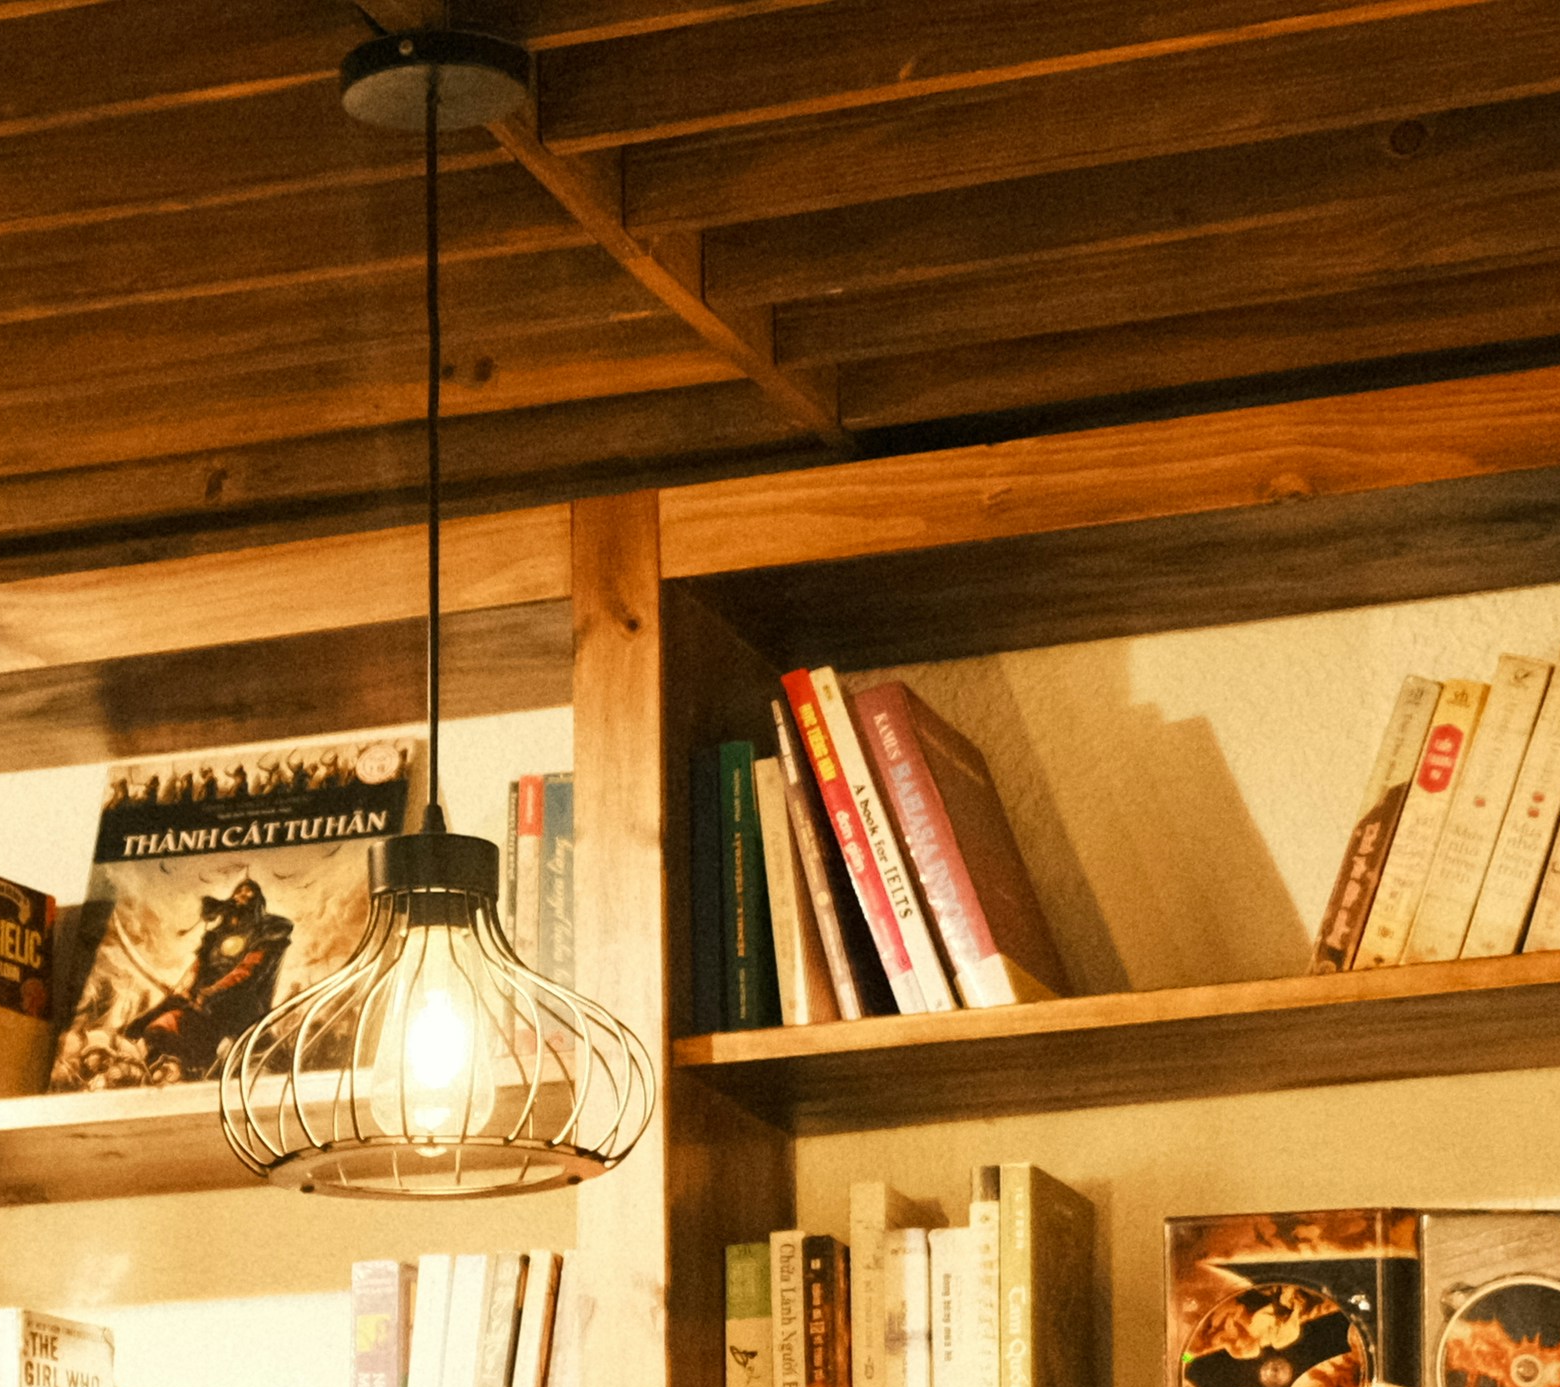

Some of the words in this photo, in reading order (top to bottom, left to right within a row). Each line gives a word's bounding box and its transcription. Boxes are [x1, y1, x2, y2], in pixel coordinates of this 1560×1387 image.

[869, 710, 903, 761] KAMUS
[123, 826, 223, 856] THÀNH
[221, 820, 282, 847] CÁT
[284, 815, 324, 841] TƯ
[323, 809, 388, 837] HÃN
[885, 760, 944, 865] BAHASA
[858, 799, 879, 837] book
[873, 839, 890, 864] for
[883, 865, 914, 920] IELTS
[778, 1286, 797, 1325] Lành
[30, 1331, 59, 1363] THE
